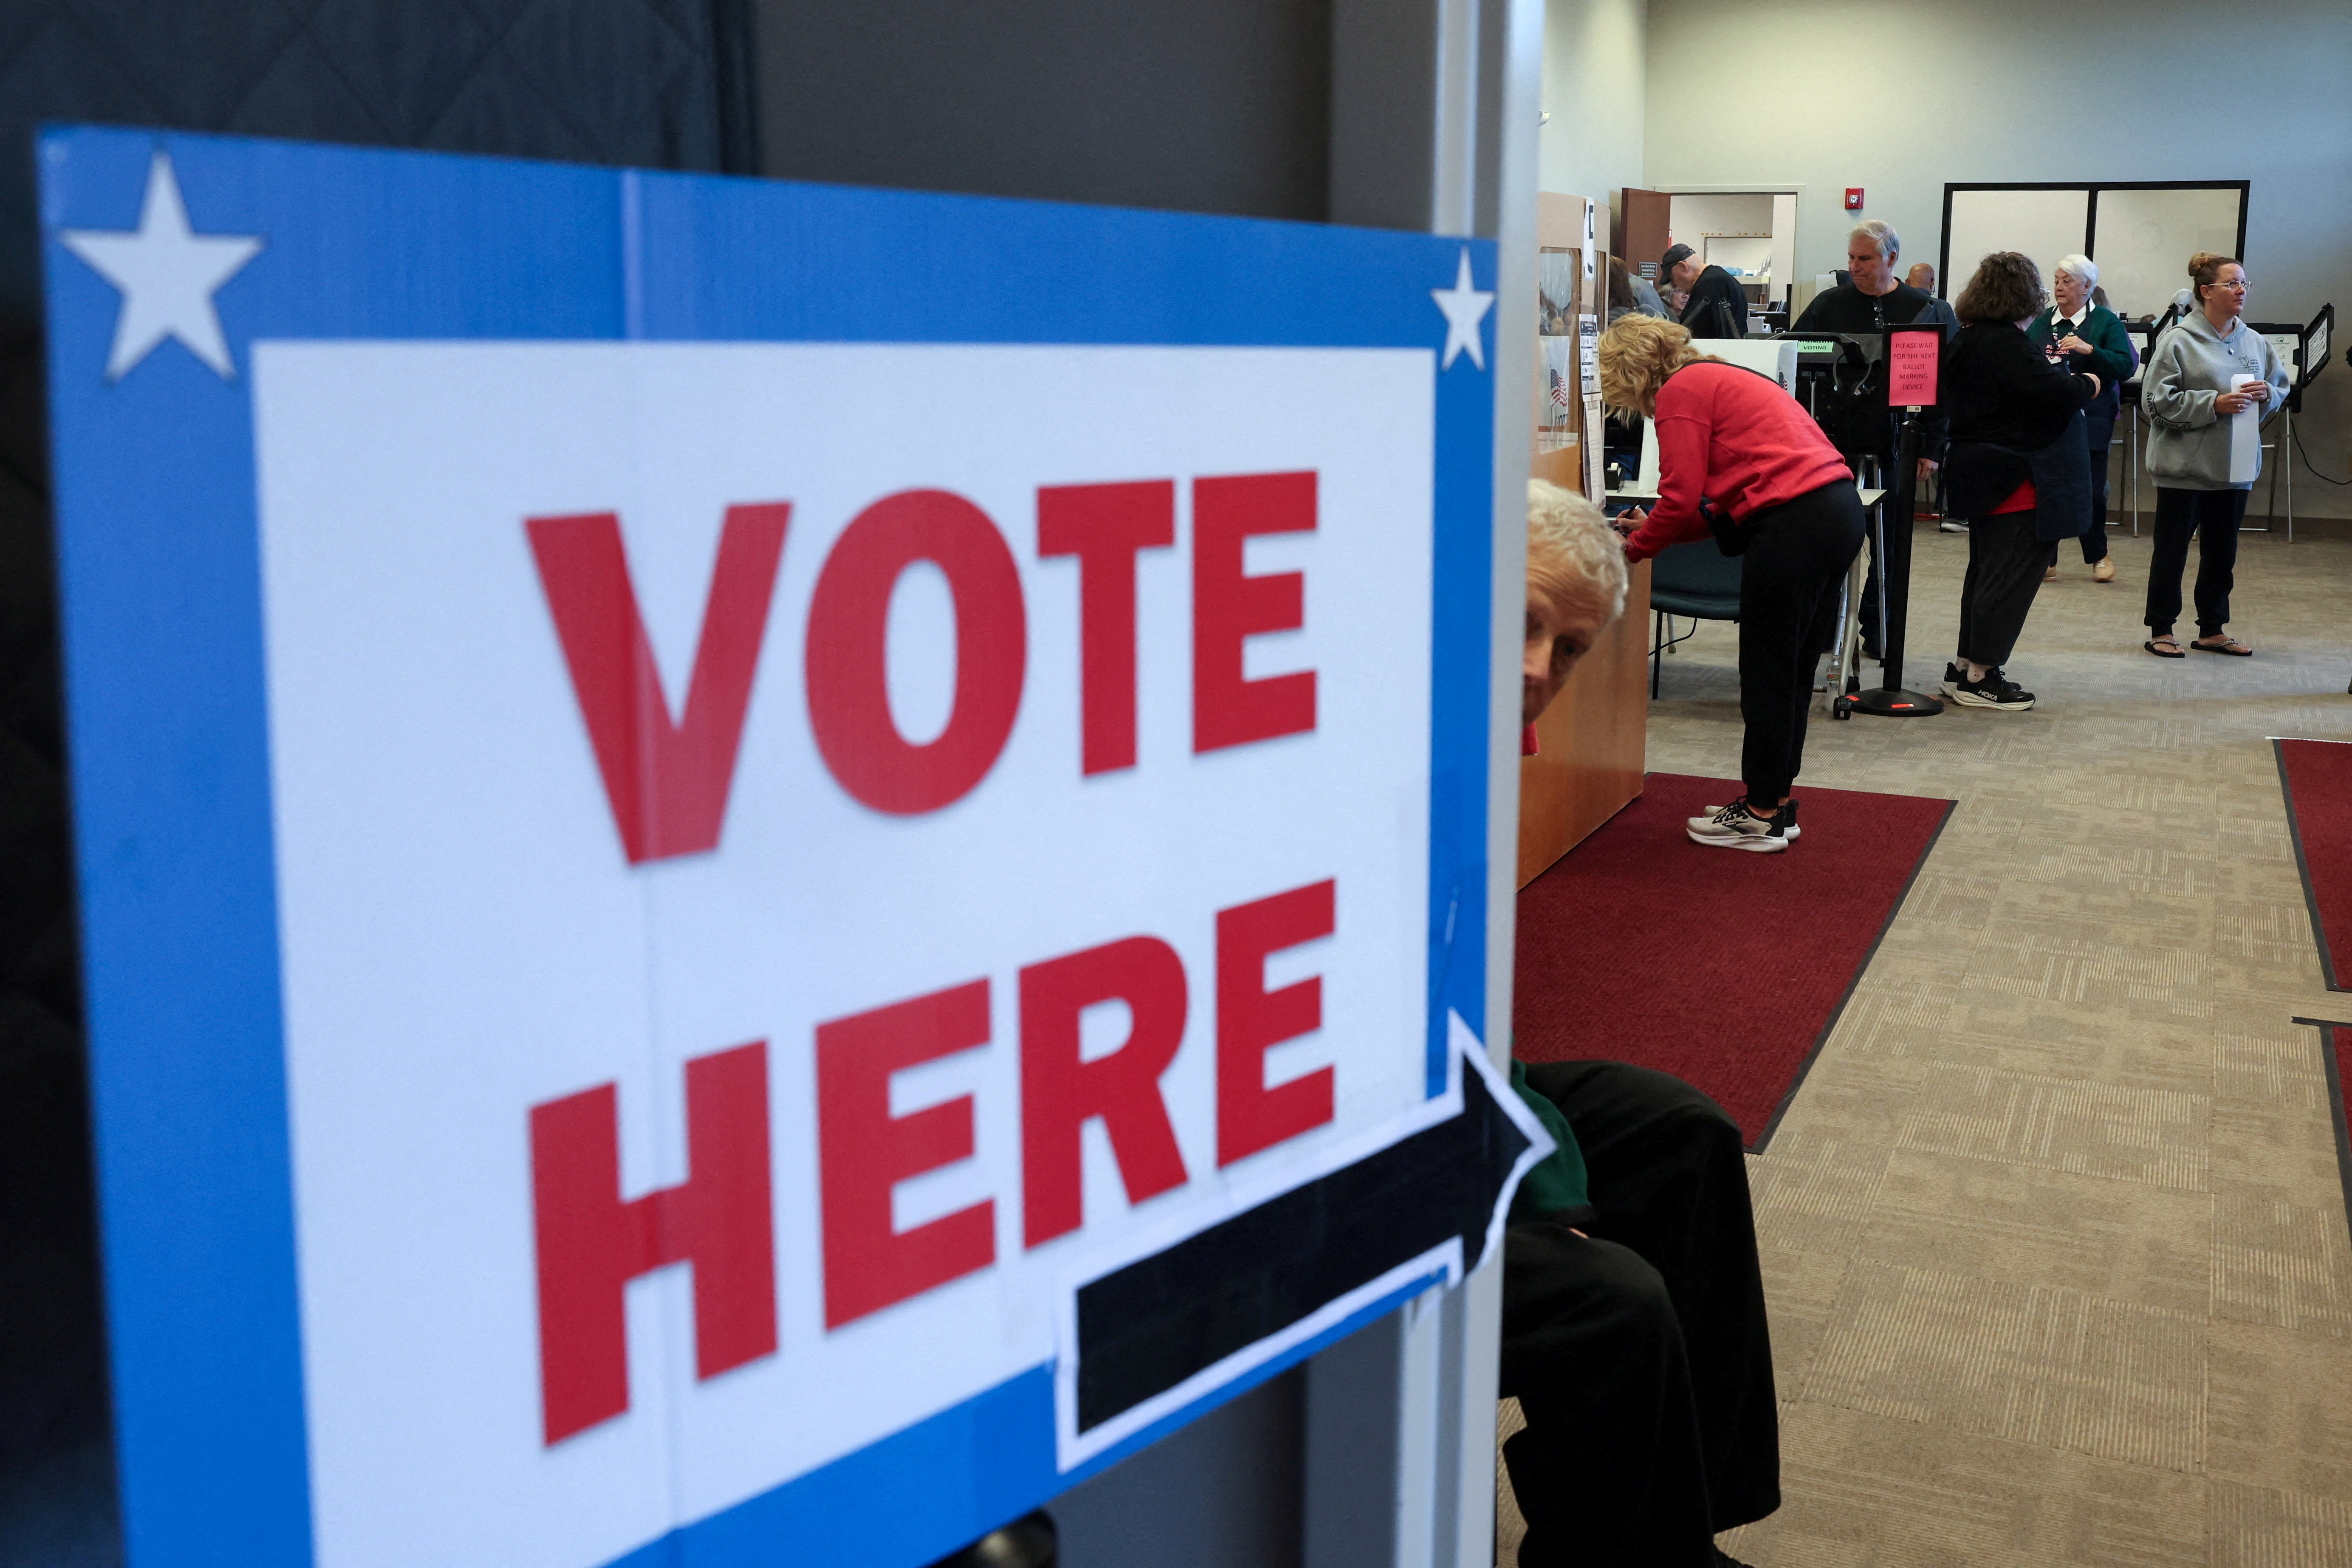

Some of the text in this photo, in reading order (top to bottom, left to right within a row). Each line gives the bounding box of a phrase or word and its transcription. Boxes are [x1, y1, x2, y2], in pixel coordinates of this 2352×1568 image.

[522, 469, 1319, 866] VOTE
[1978, 689, 1998, 701] HOKA
[528, 877, 1336, 1448] HERE
